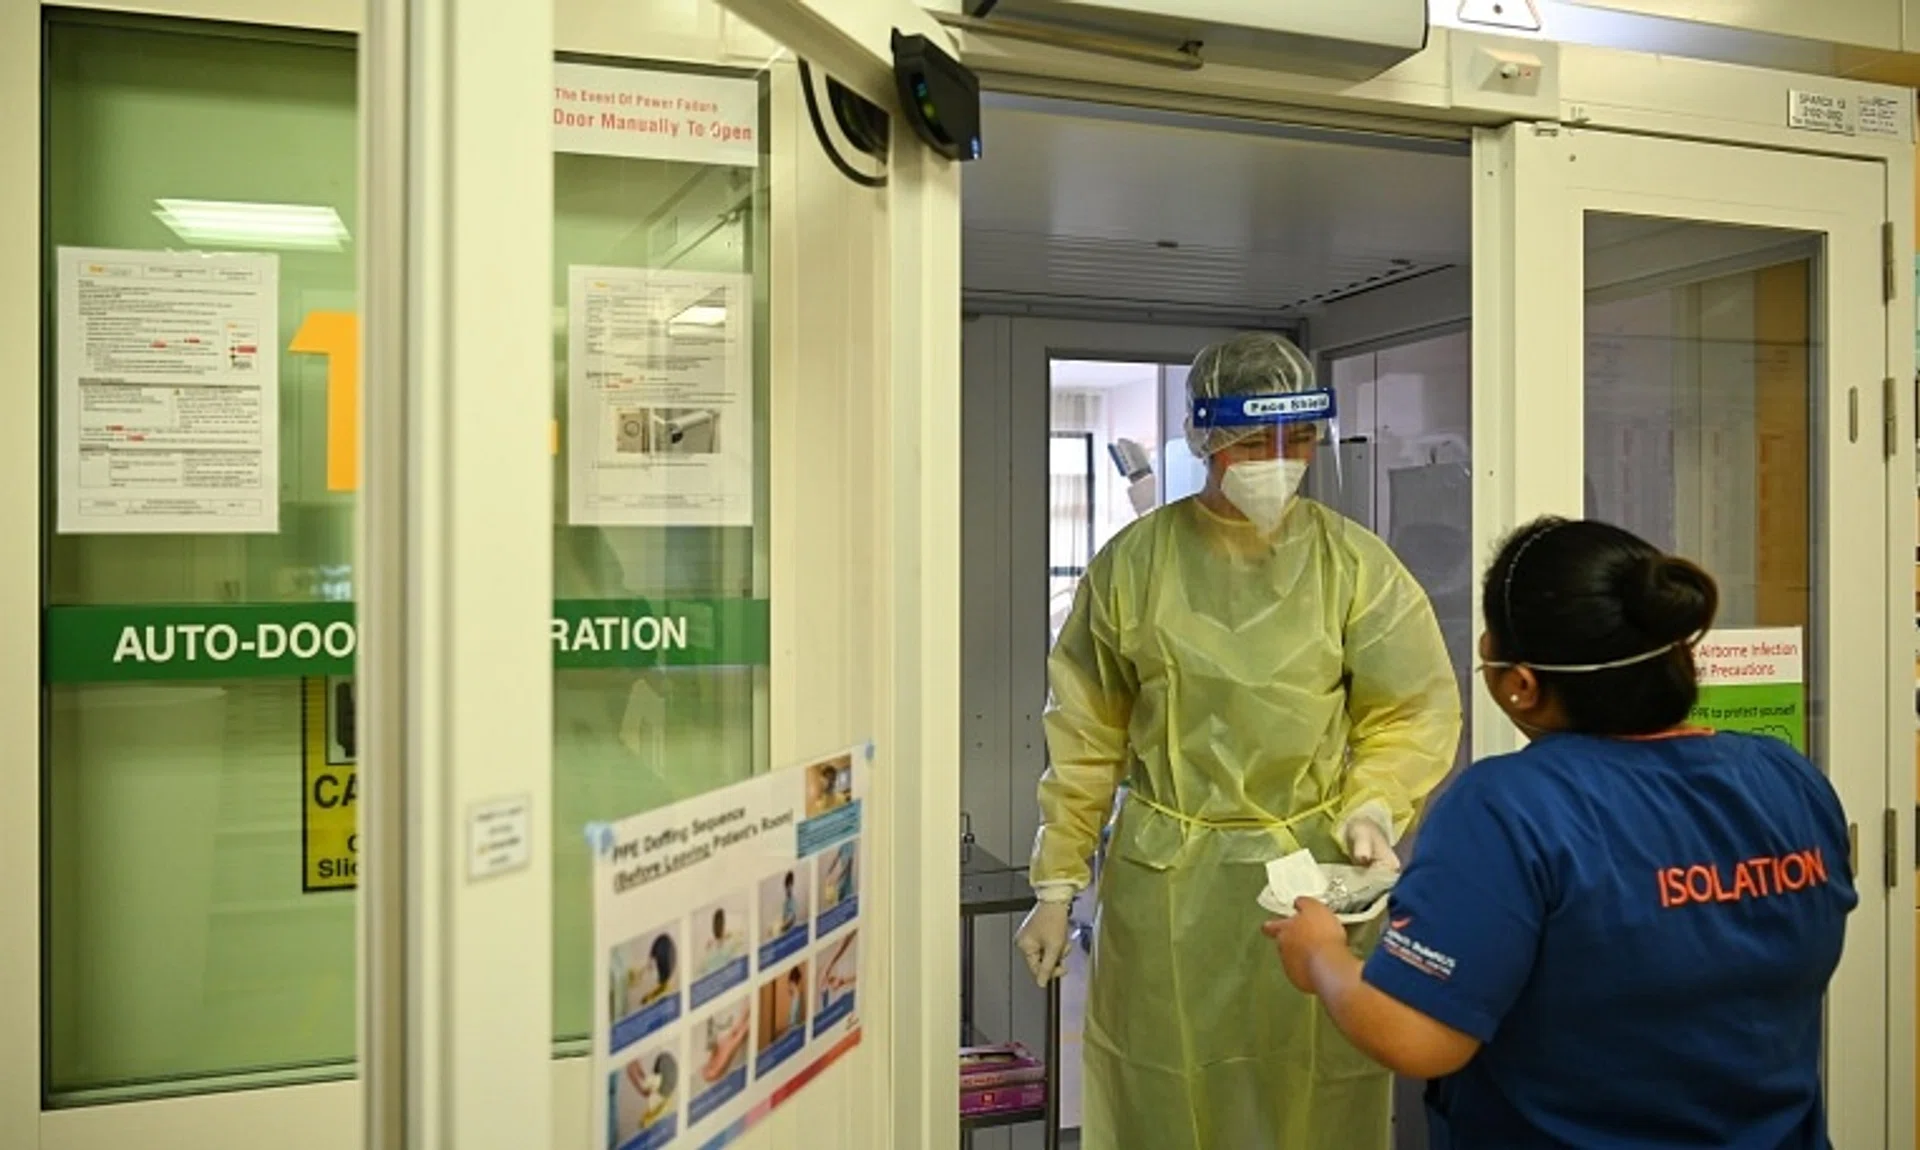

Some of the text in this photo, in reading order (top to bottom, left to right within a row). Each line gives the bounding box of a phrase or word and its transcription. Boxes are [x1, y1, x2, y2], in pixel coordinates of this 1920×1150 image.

[555, 87, 577, 101] The
[581, 90, 615, 104] Event
[637, 95, 673, 109] Power
[677, 98, 718, 113] Failure
[553, 108, 752, 142] Door Manually To Open
[1251, 402, 1285, 413] Face
[113, 616, 687, 663] AUTO-DOO RATION
[1699, 644, 1748, 658] Airborne
[1751, 641, 1797, 656] Infection
[1711, 662, 1776, 678] Precautions
[1711, 707, 1722, 719] to
[1723, 705, 1758, 720] protect
[691, 806, 746, 835] Sequence
[663, 842, 711, 875] Leaving
[1657, 845, 1828, 908] ISOLATION
